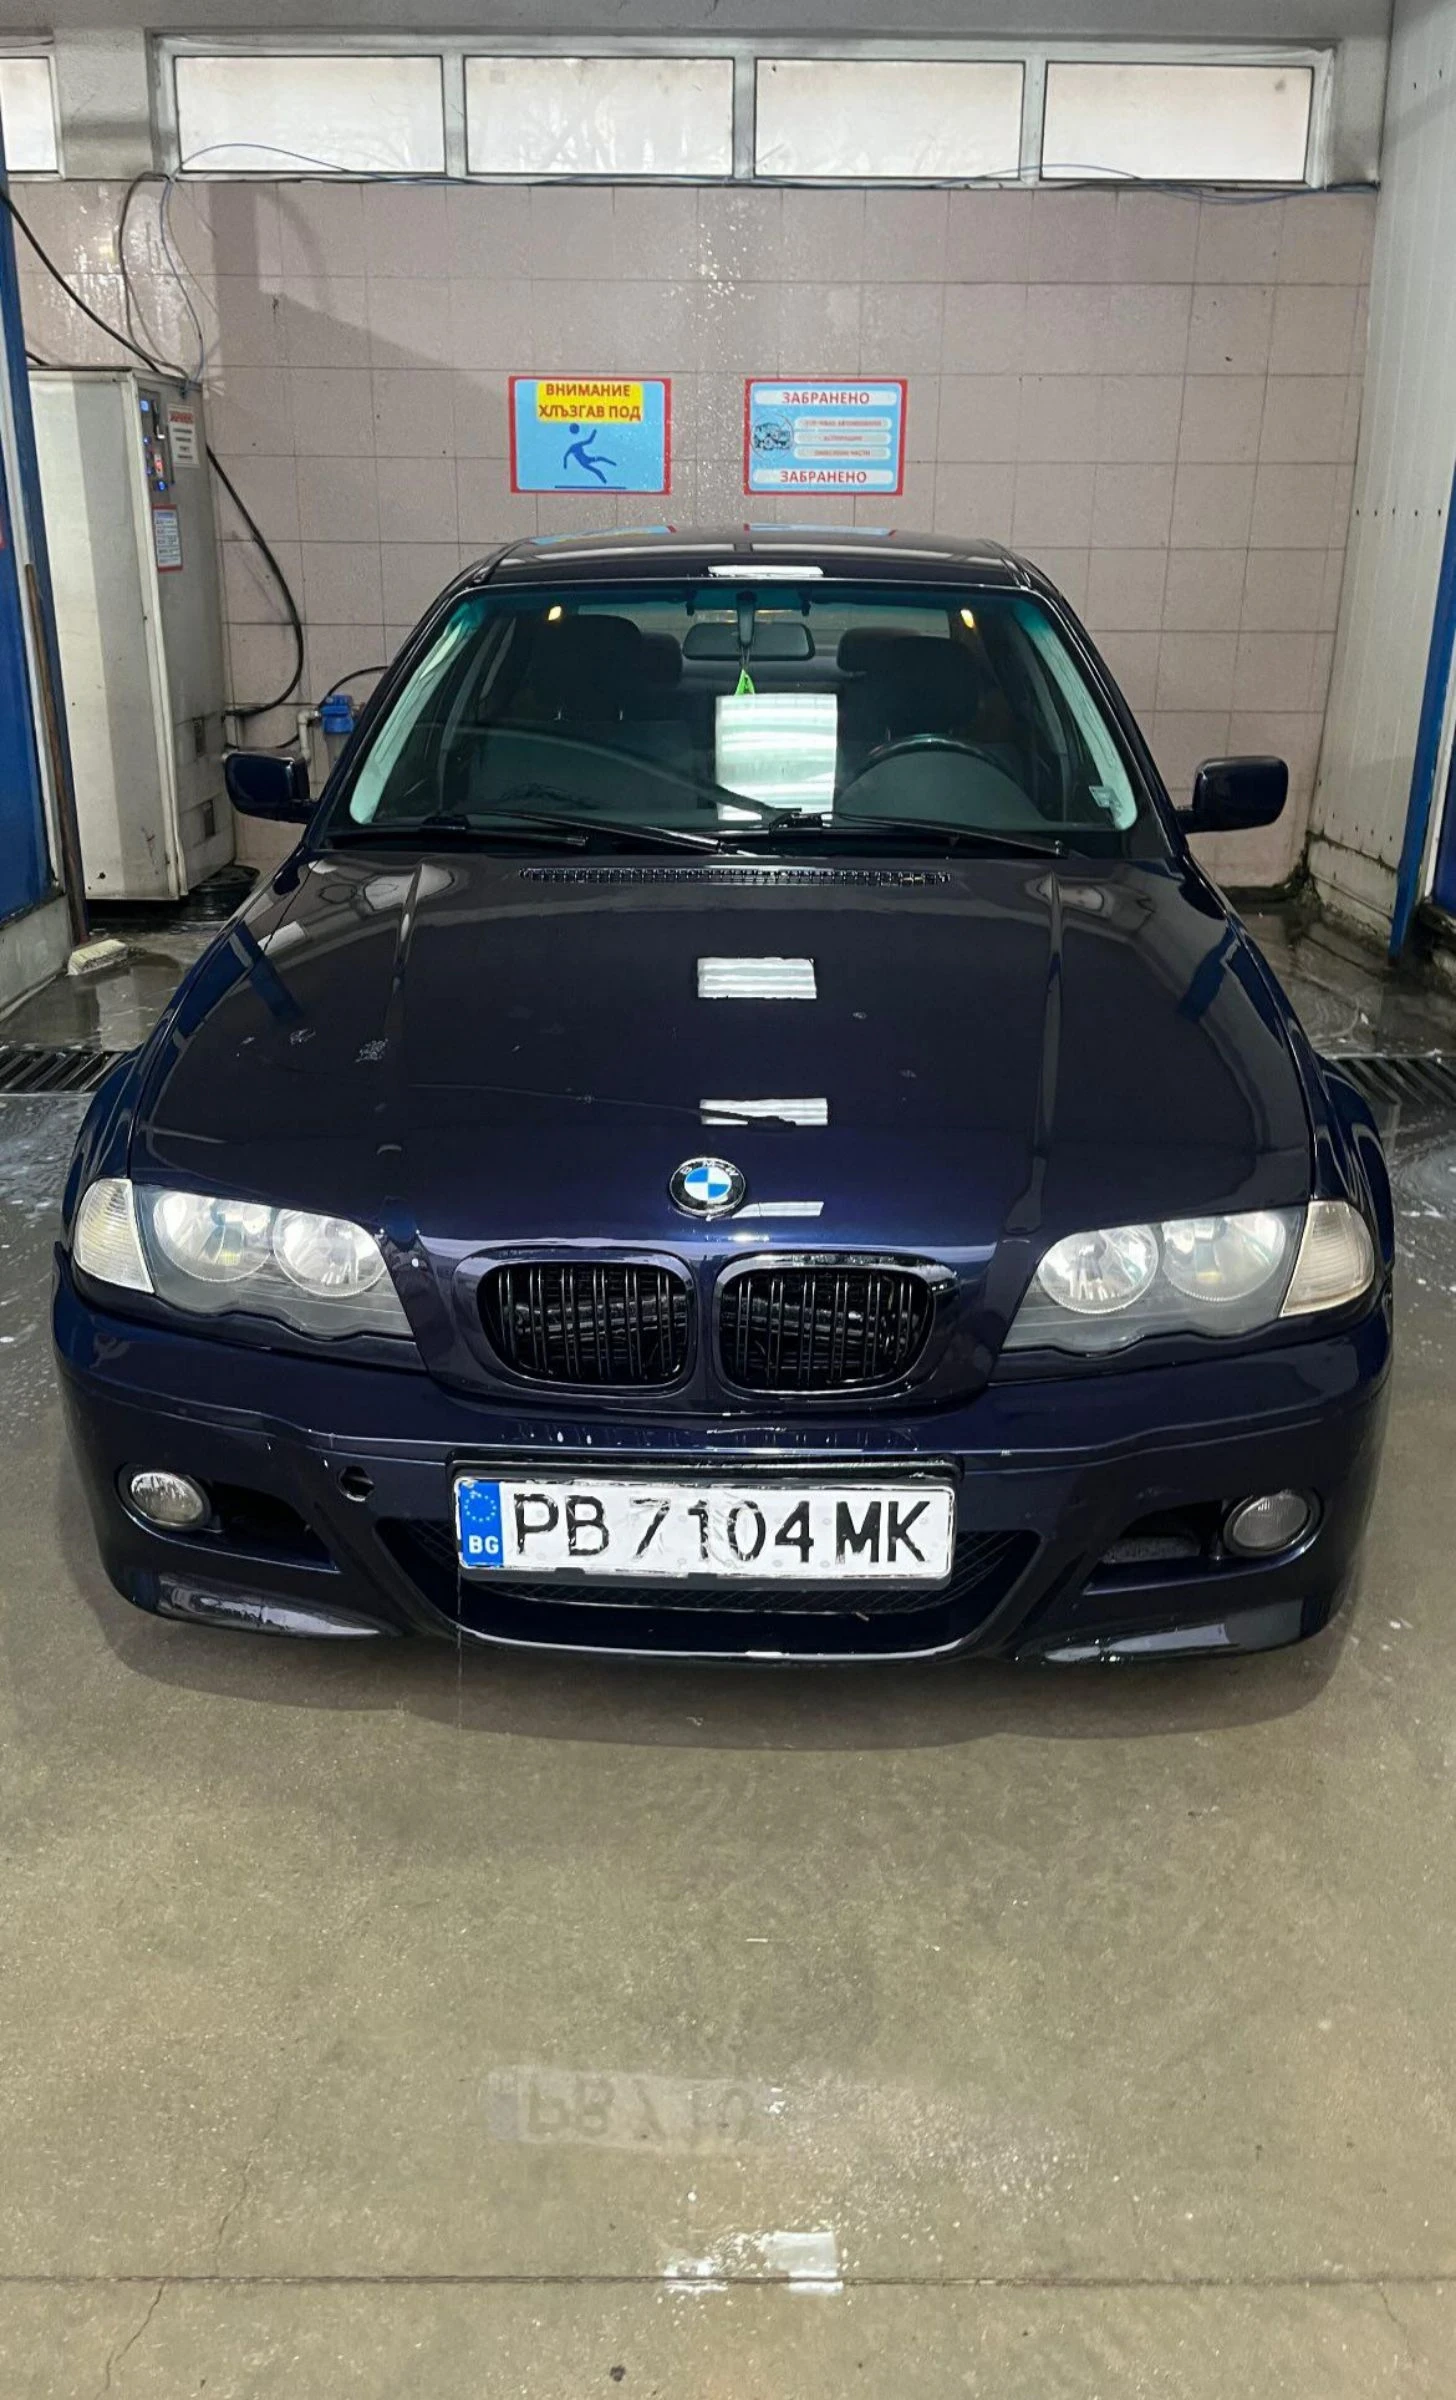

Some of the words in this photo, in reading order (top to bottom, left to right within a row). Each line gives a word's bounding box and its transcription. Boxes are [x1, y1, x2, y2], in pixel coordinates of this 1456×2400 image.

[545, 383, 631, 397] ВНИМАНИЕ
[782, 391, 870, 404] ЗАБРАНЕНО
[539, 404, 605, 418] ХЛЪЗГАВ
[609, 405, 642, 421] ПОД
[780, 470, 867, 483] ЗАБРАНЕНО
[680, 1160, 740, 1176] BMW
[514, 1493, 610, 1556] PB
[629, 1498, 815, 1563] 7104
[835, 1500, 931, 1563] MK
[468, 1535, 499, 1554] BG
